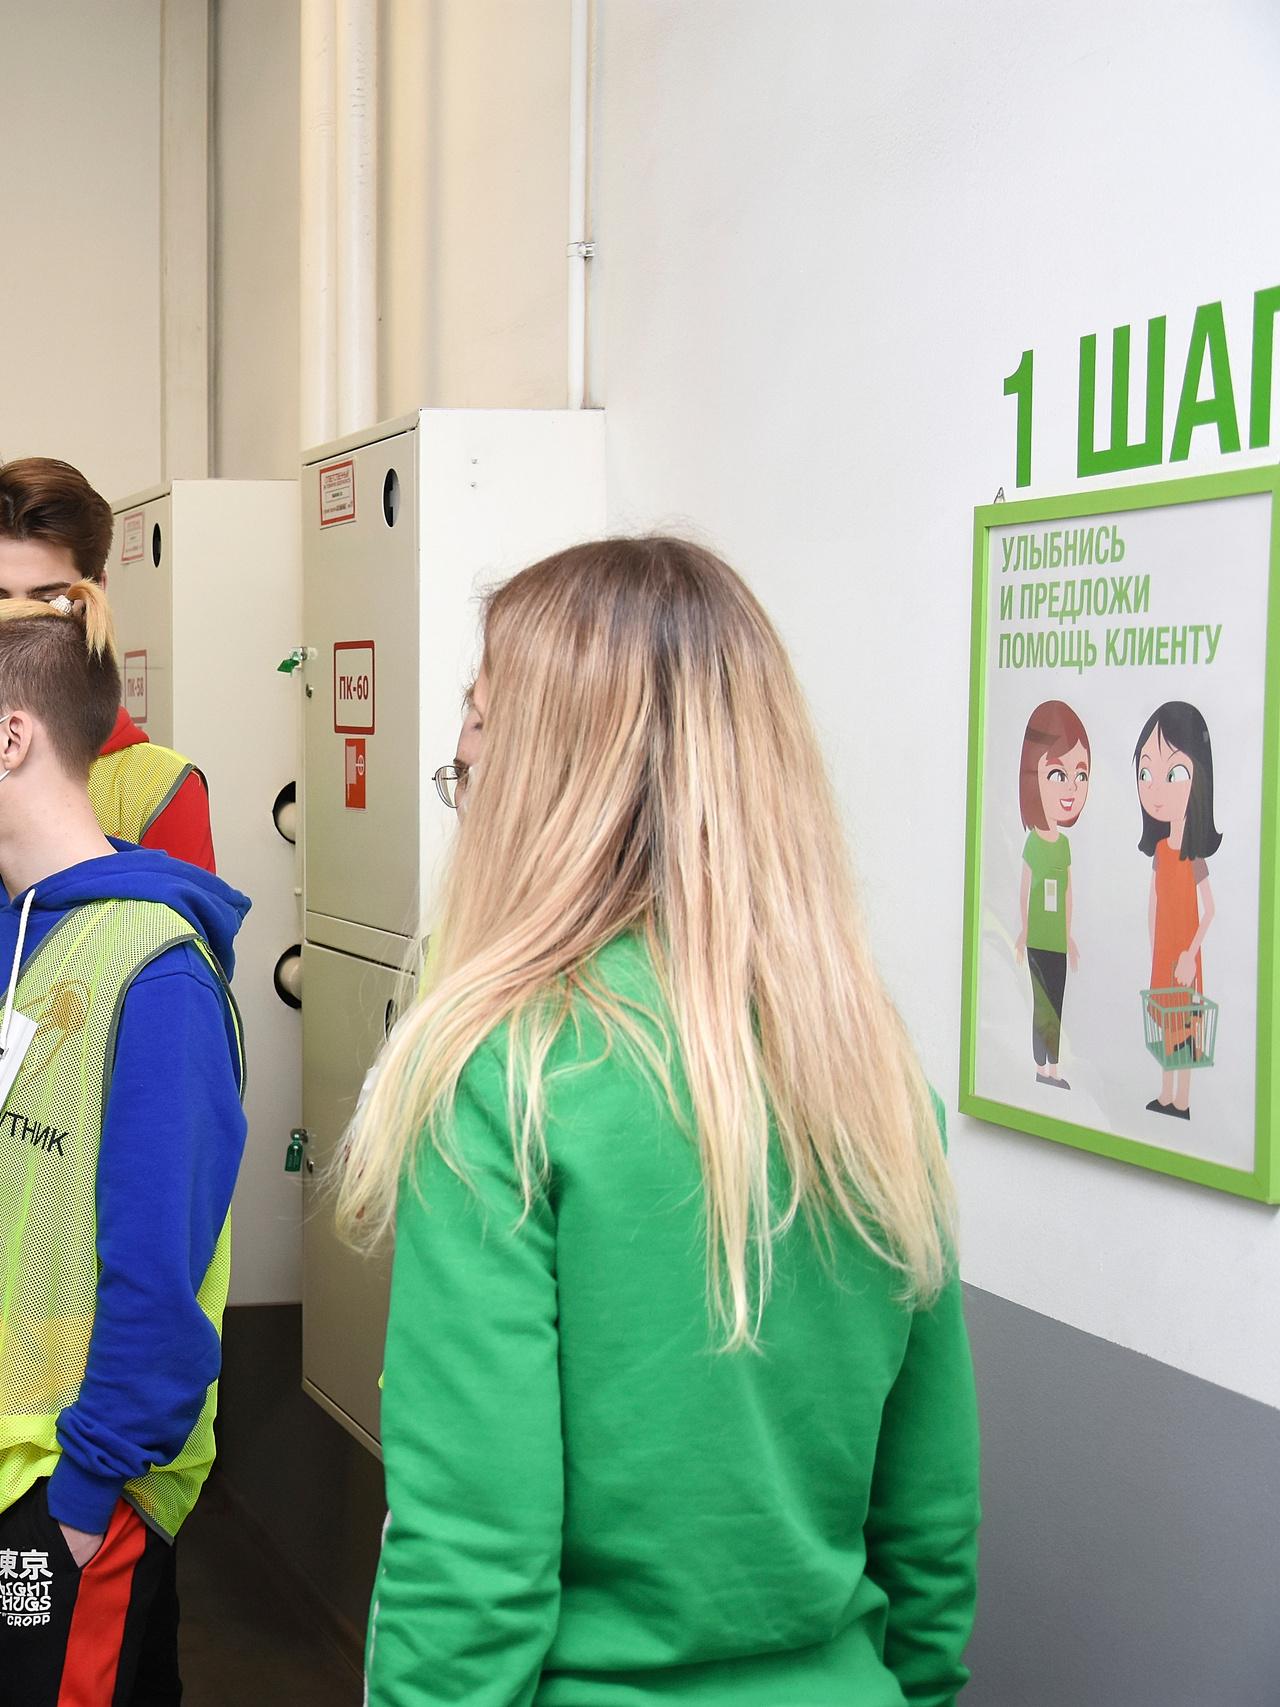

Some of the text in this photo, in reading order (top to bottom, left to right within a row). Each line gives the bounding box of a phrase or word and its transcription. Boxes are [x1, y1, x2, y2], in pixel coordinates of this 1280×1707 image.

[1004, 349, 1034, 488] 1
[1001, 525, 1126, 573] УЛЫБНИСЬ
[1000, 574, 1151, 625] И ПРЕДЛОЖИ
[998, 624, 1223, 675] ПОМОЩЬ КЛИЕНТУ
[339, 675, 369, 700] ПК-60
[6, 1614, 51, 1627] CROPP
